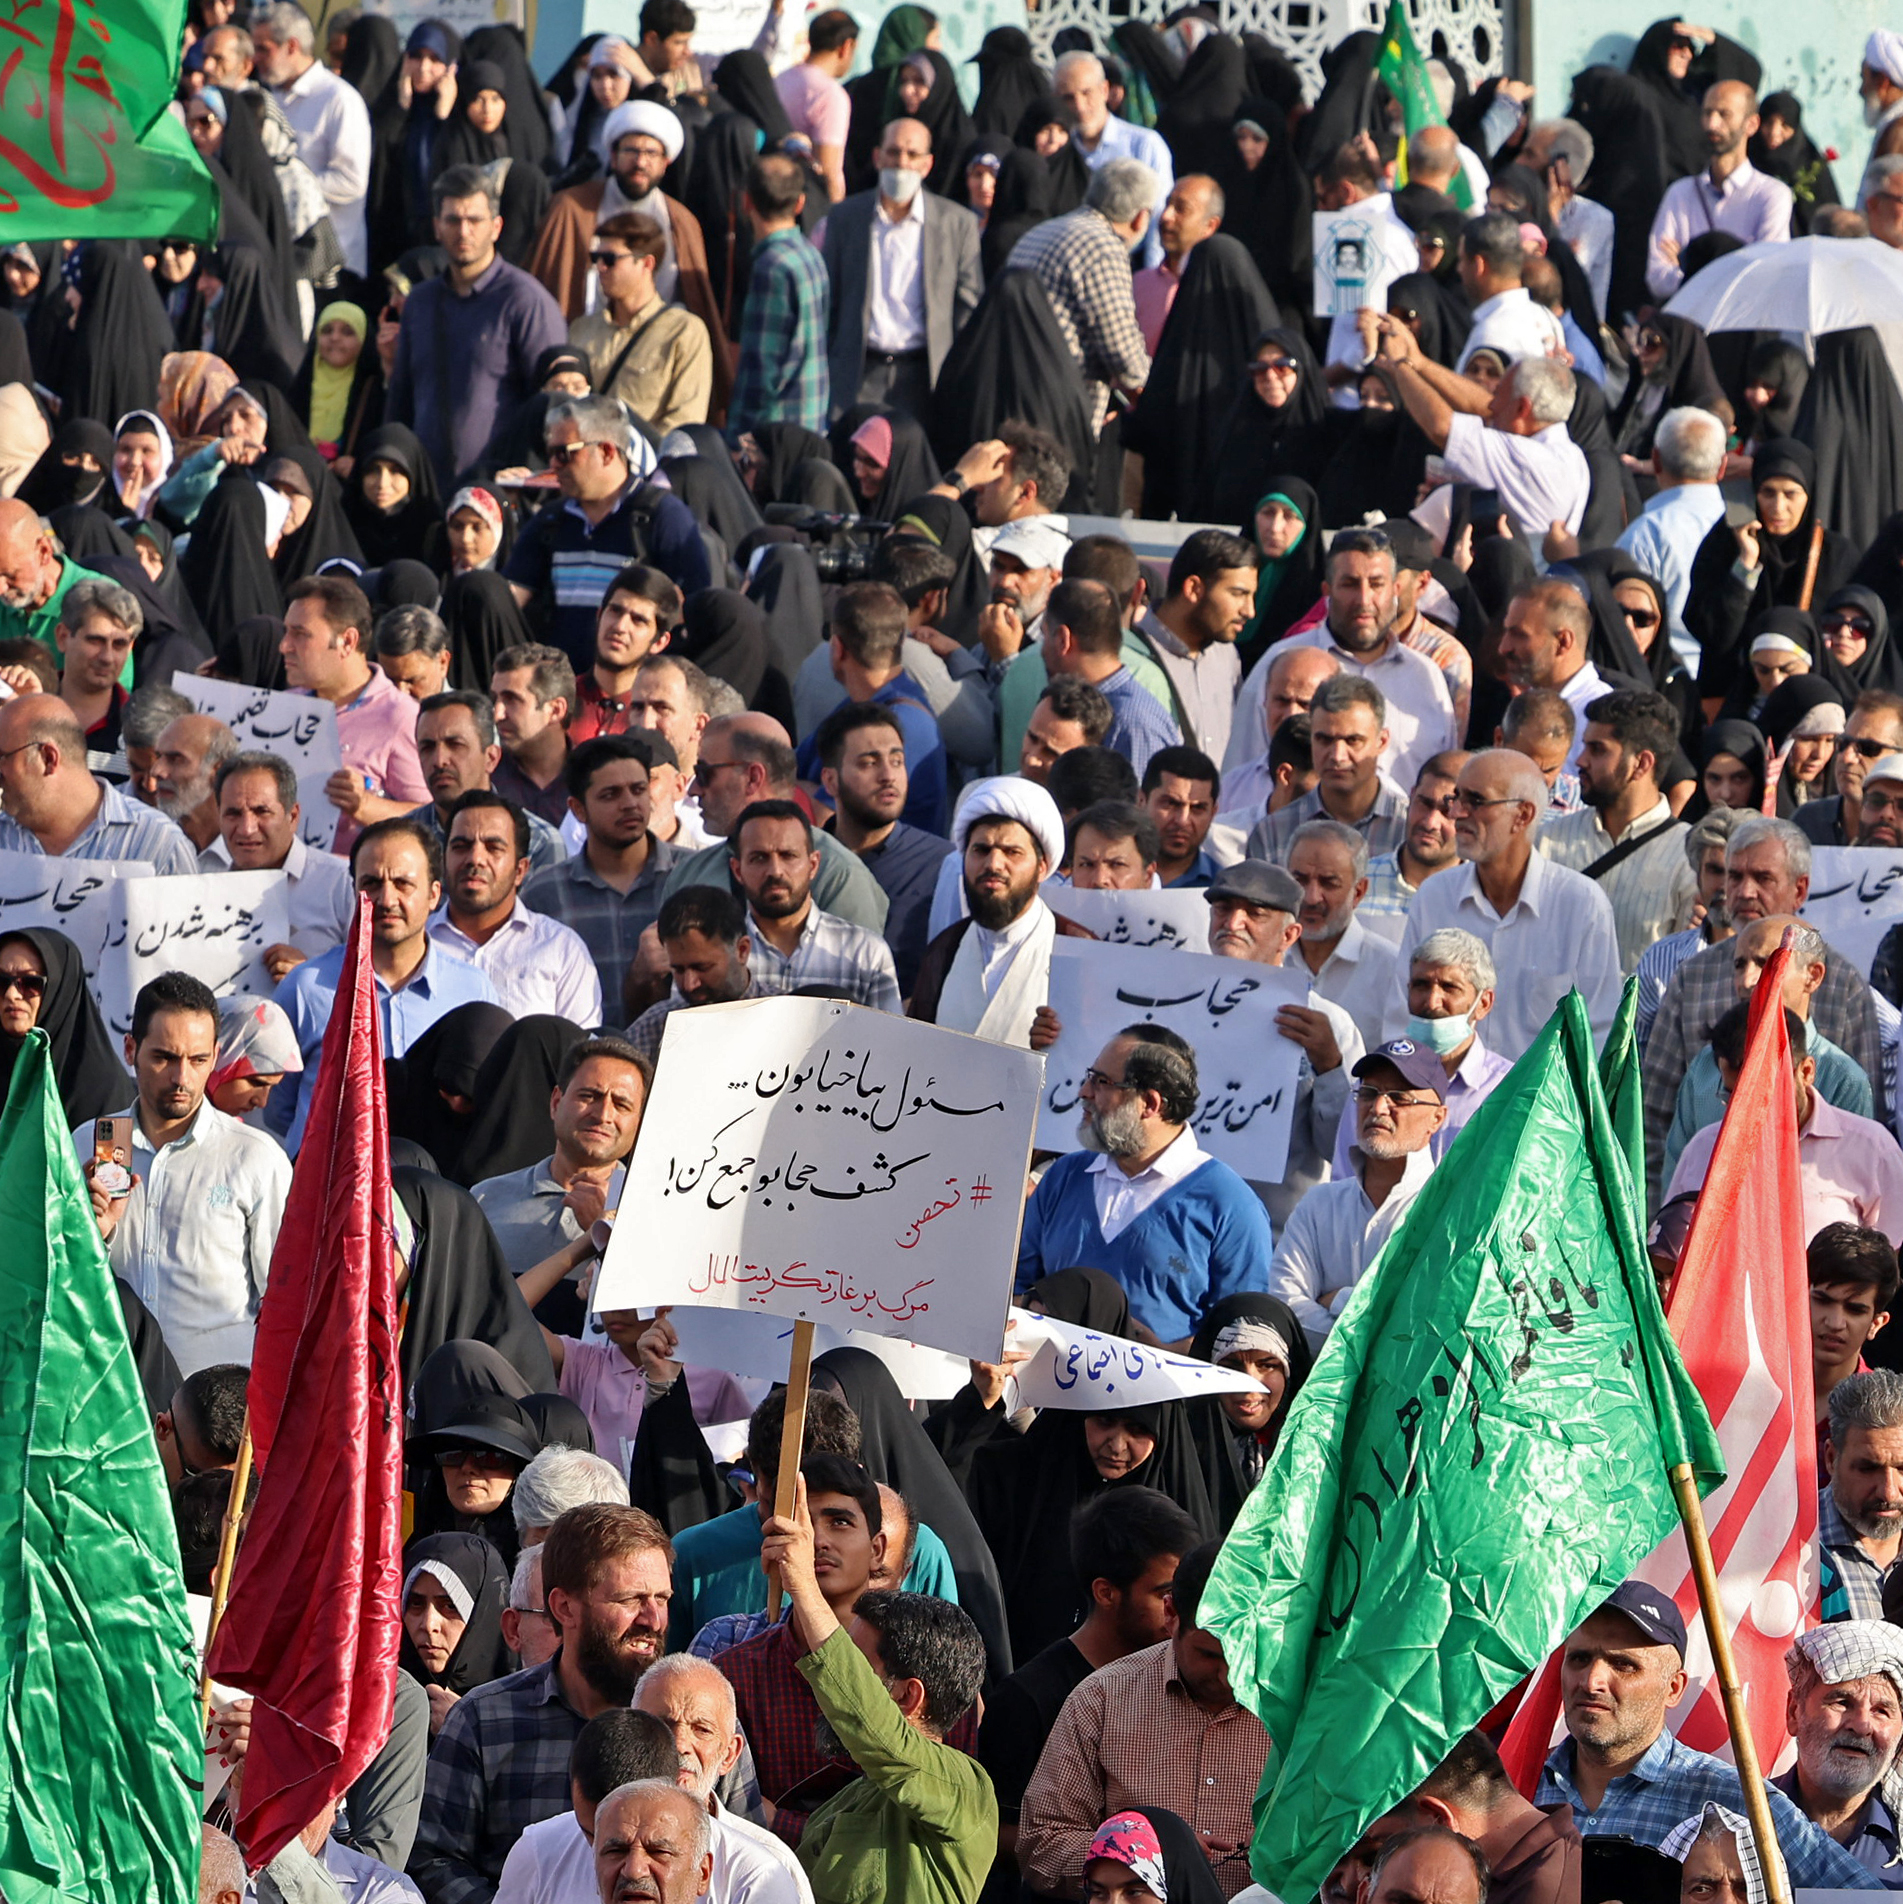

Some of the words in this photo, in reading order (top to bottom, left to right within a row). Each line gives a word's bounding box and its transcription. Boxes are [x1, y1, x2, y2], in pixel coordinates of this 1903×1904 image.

[252, 714, 321, 756] حجاب
[1116, 977, 1261, 1029] حجاب
[706, 1155, 757, 1211] جمع
[809, 1151, 932, 1201] کشف
[876, 1278, 936, 1322] مرگ
[1054, 1334, 1118, 1392] اجتماعی
